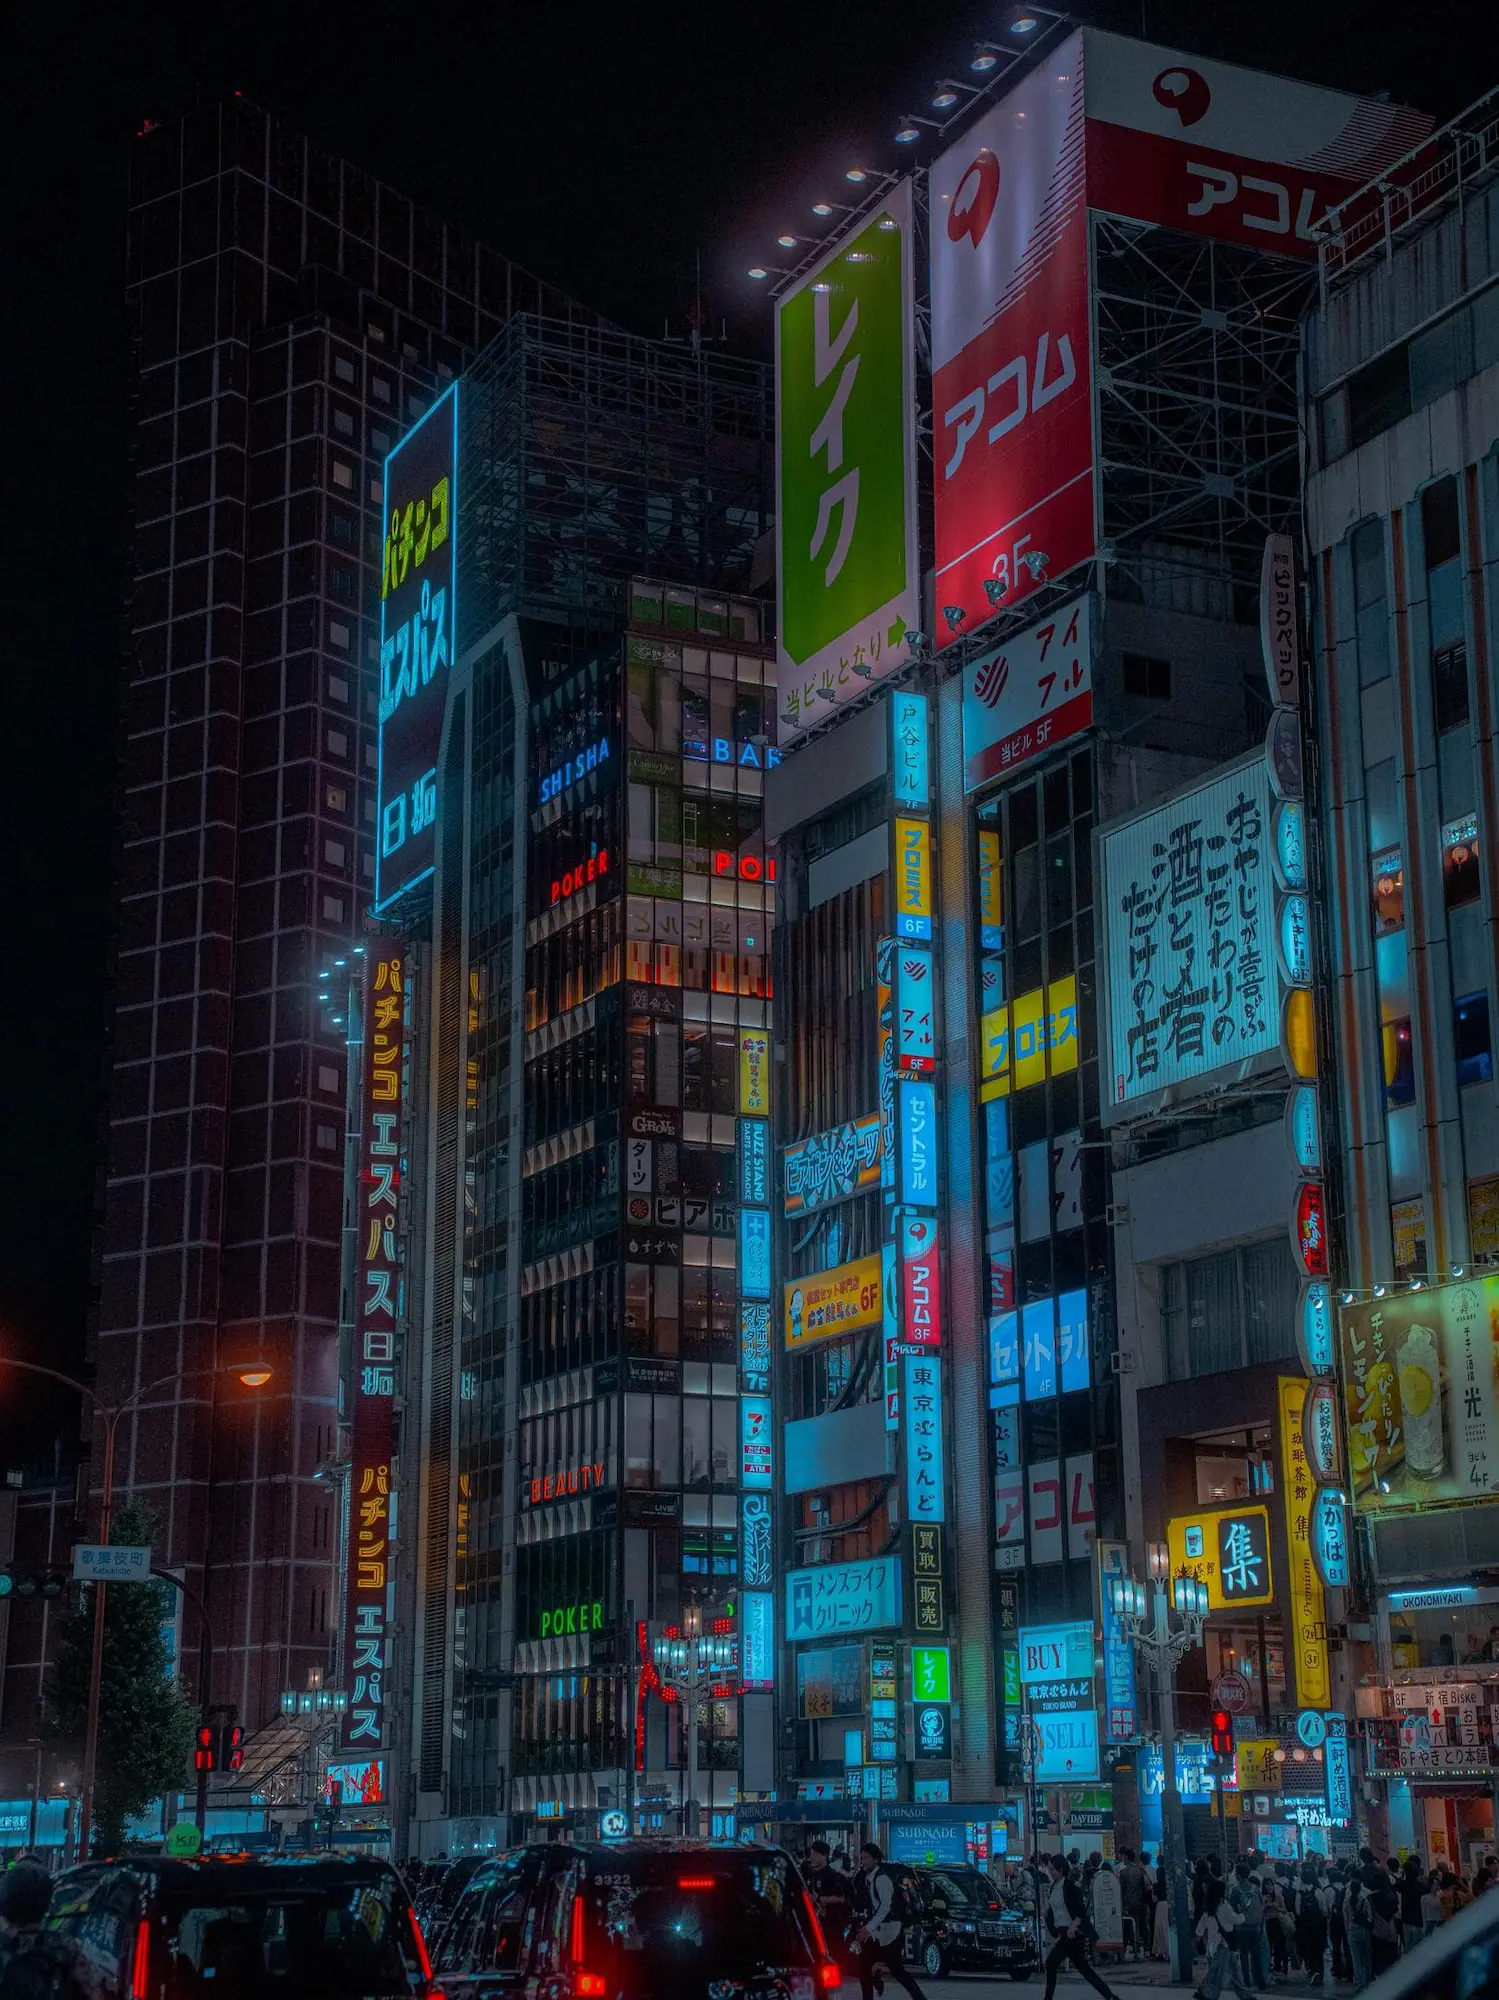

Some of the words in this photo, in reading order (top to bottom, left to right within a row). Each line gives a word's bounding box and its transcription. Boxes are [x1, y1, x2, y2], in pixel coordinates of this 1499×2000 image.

[944, 330, 1077, 481] アコム
[809, 296, 862, 587] レイク
[382, 474, 448, 600] パチンコ
[379, 579, 448, 723] エスパス
[1037, 608, 1079, 662] アイ
[1037, 659, 1083, 708] フル
[900, 705, 920, 790] 戸谷ビル
[1001, 733, 1033, 765] 当ビル
[1036, 718, 1052, 744] 5F
[540, 736, 611, 804] SHISHA
[549, 848, 609, 904] POKER
[904, 829, 922, 907] プロミス
[904, 919, 925, 933] 6F
[1205, 834, 1237, 1046] こだわりの
[1122, 881, 1170, 1083] だけの店
[1292, 967, 1309, 980] 6F
[373, 959, 400, 1101] パチンコ
[902, 1008, 931, 1026] アイ
[902, 1029, 932, 1044] フル
[989, 1004, 1078, 1073] プロミス
[910, 1058, 924, 1068] 5F
[632, 1116, 676, 1136] GROVE
[754, 1123, 764, 1157] BUZZ
[910, 1096, 928, 1190] セントラル
[633, 1142, 646, 1186] ダーツ
[754, 1159, 764, 1201] STAND
[364, 1112, 397, 1319] エスパス
[657, 1200, 735, 1230] ビアポ
[861, 1283, 878, 1311] 6F
[912, 1266, 931, 1324] アコム
[914, 1328, 930, 1340] 3F
[993, 1320, 1089, 1378] セントラル
[746, 1372, 768, 1390] 7F
[1464, 1387, 1481, 1418] 光
[530, 1463, 605, 1504] BEAUTY
[750, 1464, 766, 1473] ATM
[1470, 1465, 1488, 1487] 4F
[996, 1473, 1097, 1538] アコム
[356, 1464, 389, 1589] パチンコ
[1323, 1508, 1344, 1562] かっぱ
[81, 1551, 143, 1565] 歌舞伎町
[919, 1531, 936, 1569] 買取
[1005, 1550, 1019, 1565] 3F
[1222, 1523, 1263, 1591] 集
[92, 1567, 132, 1575] Kabukicho
[816, 1565, 886, 1598] メンズライフ
[1303, 1558, 1311, 1616] Premium
[1329, 1568, 1344, 1580] B1
[816, 1600, 873, 1631] クリニック
[919, 1586, 937, 1624] 販売
[1402, 1593, 1462, 1608] OKONOMIYAKI
[541, 1603, 603, 1637] POKER
[349, 1605, 384, 1740] エスパス
[924, 1652, 936, 1693] レイク
[1026, 1643, 1063, 1671] BUY
[1307, 1654, 1317, 1664] 3F
[1046, 1722, 1093, 1750] SELL
[1260, 1747, 1279, 1782] 集
[1331, 1740, 1348, 1812] 一軒め酒場
[740, 1806, 774, 1818] SUBNADE
[882, 1808, 926, 1818] SUBNADE
[1071, 1814, 1102, 1824] DAVIDE
[897, 1827, 957, 1839] SUBNADE
